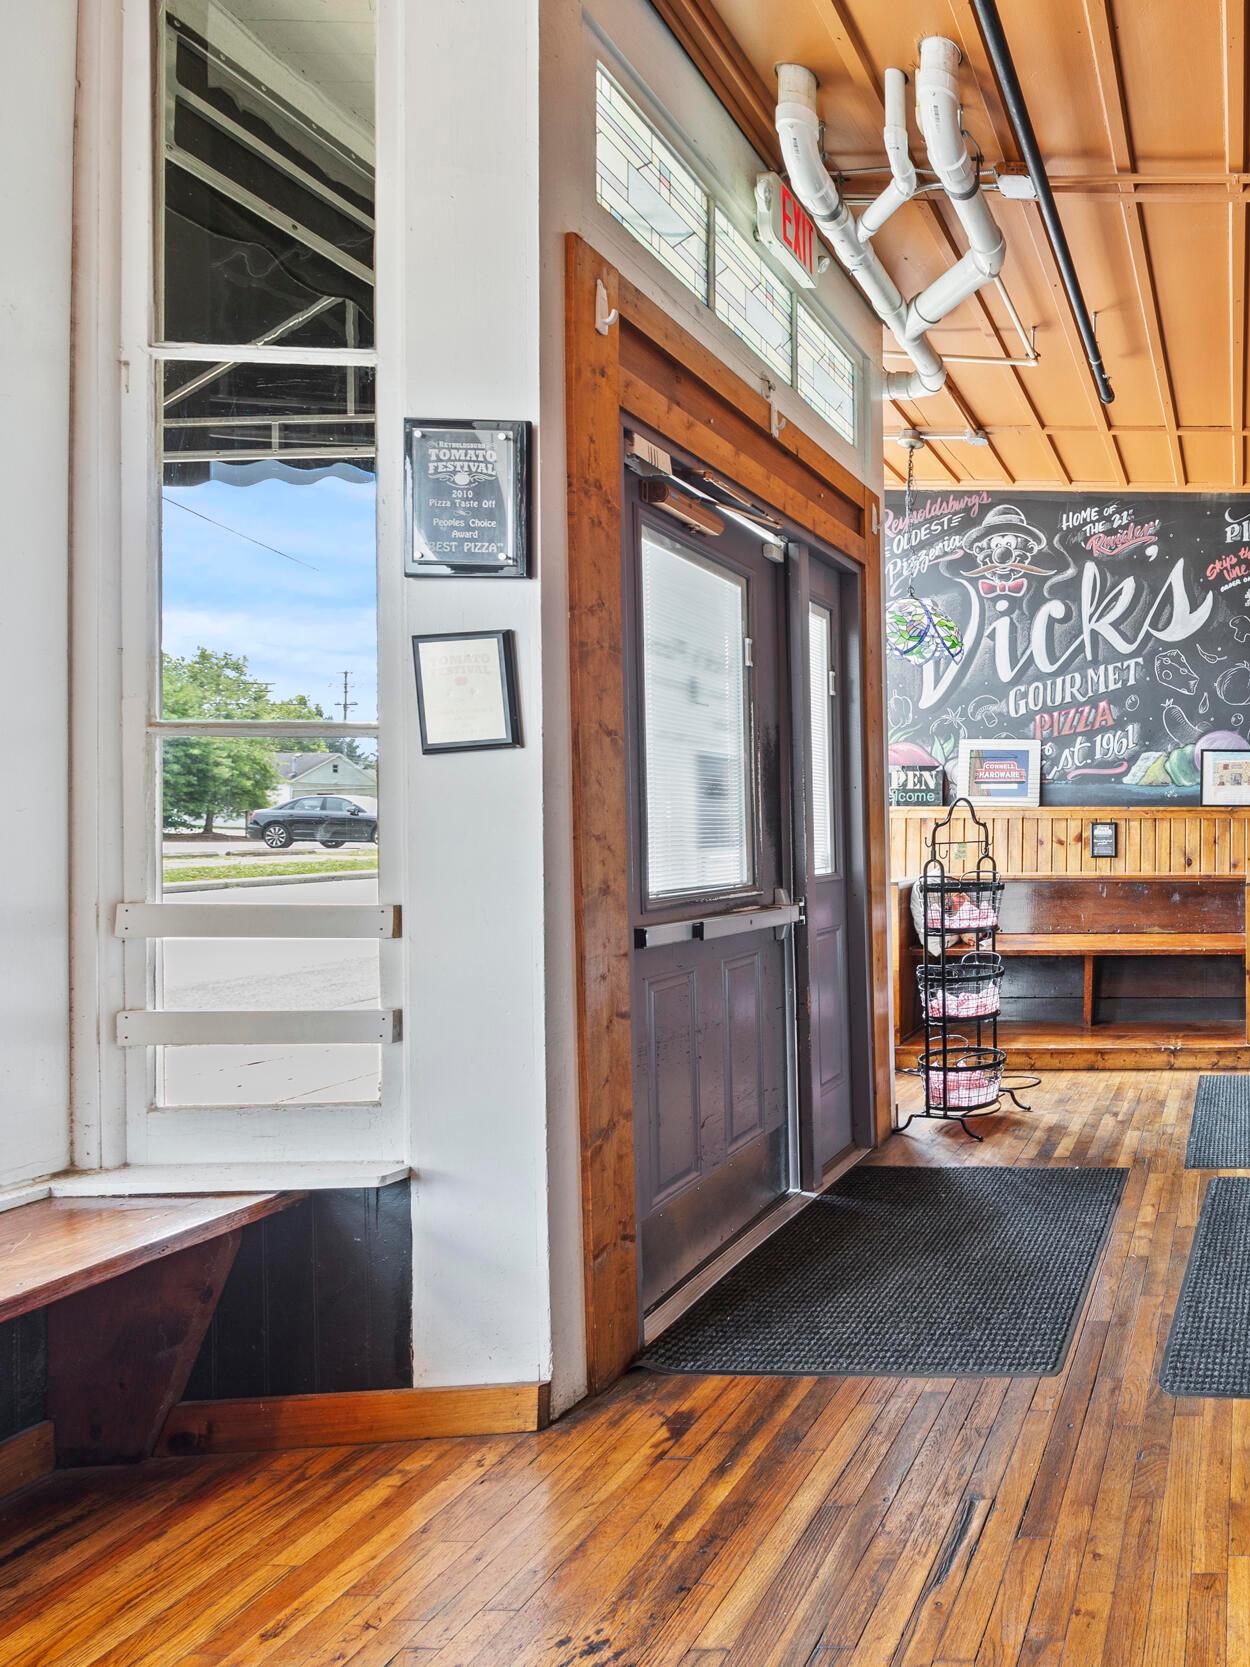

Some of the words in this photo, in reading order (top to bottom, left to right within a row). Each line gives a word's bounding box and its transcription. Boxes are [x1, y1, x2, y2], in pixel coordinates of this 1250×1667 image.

[782, 182, 813, 274] EXIT
[428, 449, 497, 462] TOMATO
[428, 462, 496, 475] FESTIVAL
[452, 490, 473, 498] 2010
[428, 499, 450, 507] Pizza
[456, 500, 478, 508] Taste
[482, 500, 496, 508] Off
[433, 518, 465, 527] Peoples
[469, 519, 497, 528] Choice
[1062, 507, 1099, 530] HOME
[1104, 505, 1118, 516] OF
[452, 530, 478, 538] Award
[893, 514, 952, 554] OLDEST
[1082, 520, 1105, 536] THE
[1206, 554, 1237, 580] Skip
[1220, 580, 1241, 593] ORDER
[1008, 657, 1143, 718] GOURMET
[1035, 699, 1114, 740] PIZZA
[1093, 723, 1137, 760] 1961
[890, 770, 937, 789] PEN
[889, 790, 934, 801] elcome
